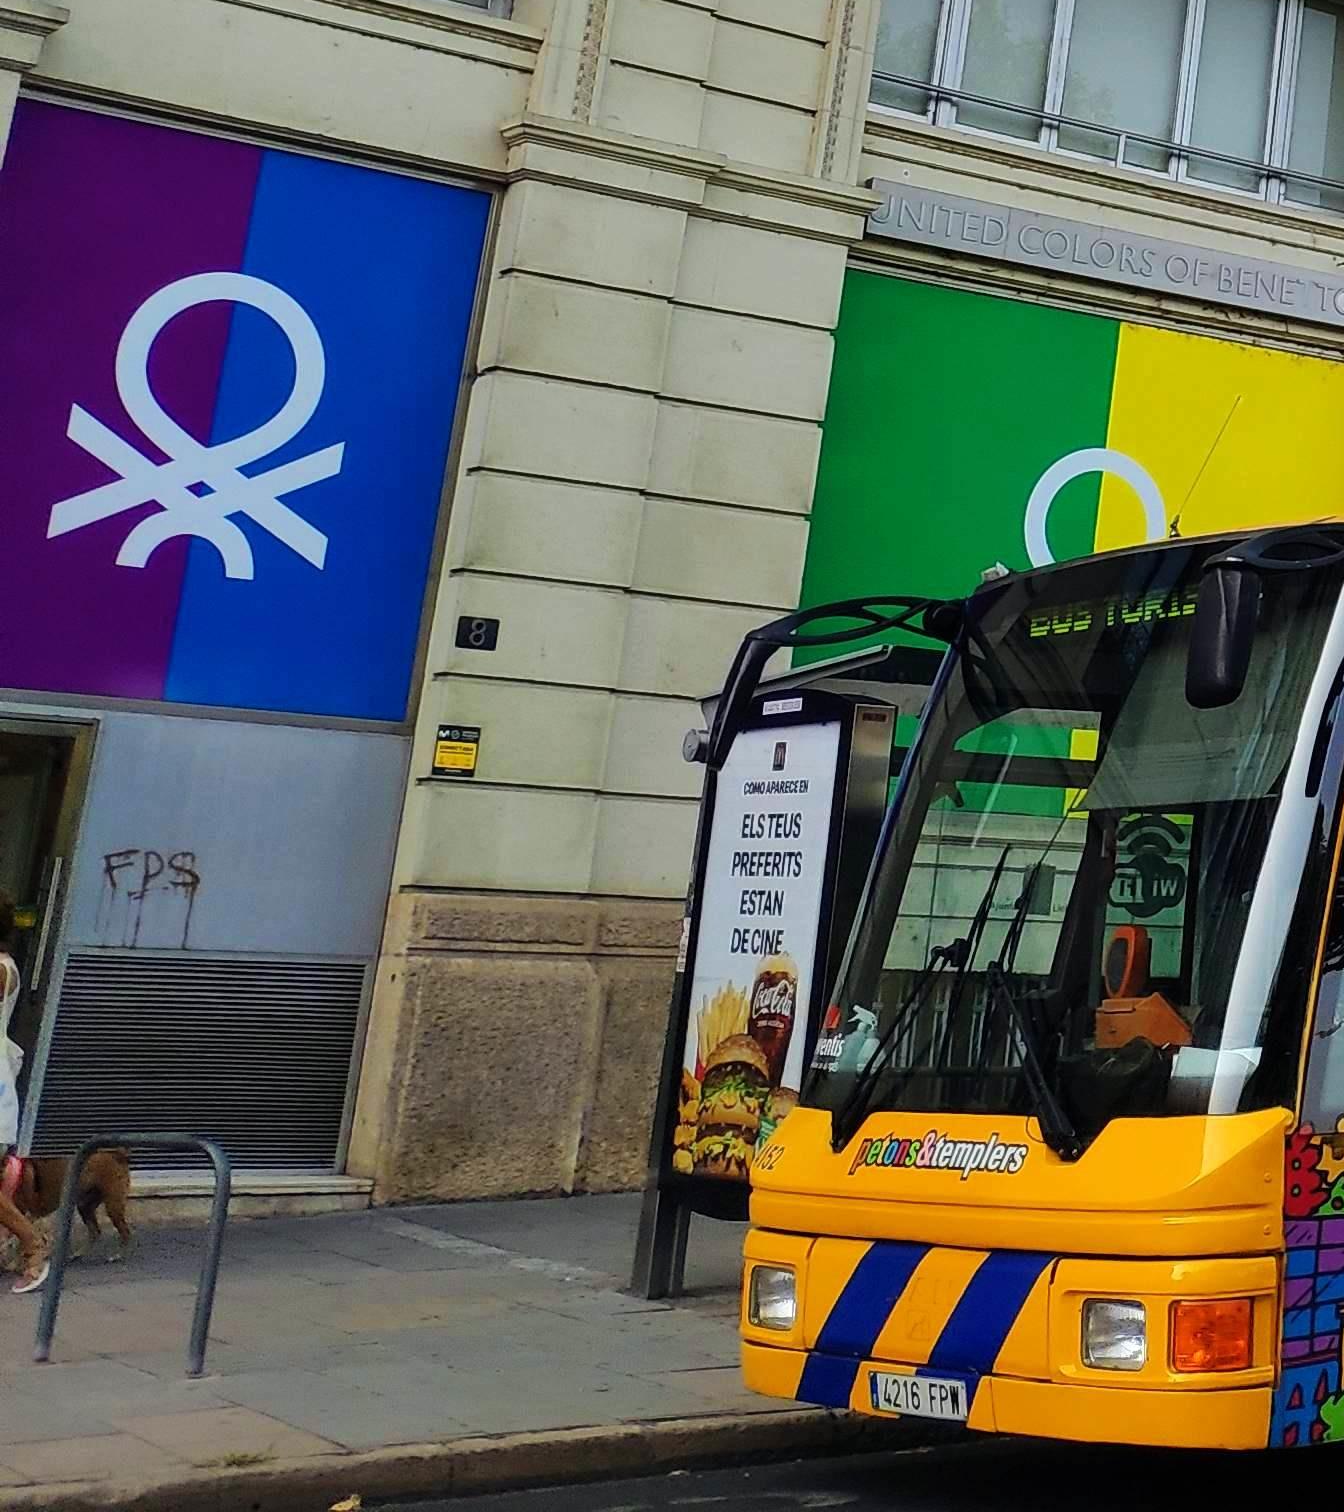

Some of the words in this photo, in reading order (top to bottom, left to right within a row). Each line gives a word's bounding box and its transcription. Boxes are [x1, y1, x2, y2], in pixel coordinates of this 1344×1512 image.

[1016, 224, 1155, 277] COLORS
[1164, 254, 1209, 287] OF
[469, 619, 487, 646] 8
[744, 781, 766, 796] COMO
[766, 780, 799, 795] APARECE
[798, 779, 809, 793] EN
[741, 813, 766, 839] ELS
[767, 813, 802, 839] TEUS
[731, 851, 803, 877] PREFERITS
[739, 890, 785, 916] ESTAN
[730, 928, 751, 954] DE
[750, 929, 785, 956] CINE
[883, 1377, 921, 1411] 4216
[928, 1382, 960, 1416] FPW
